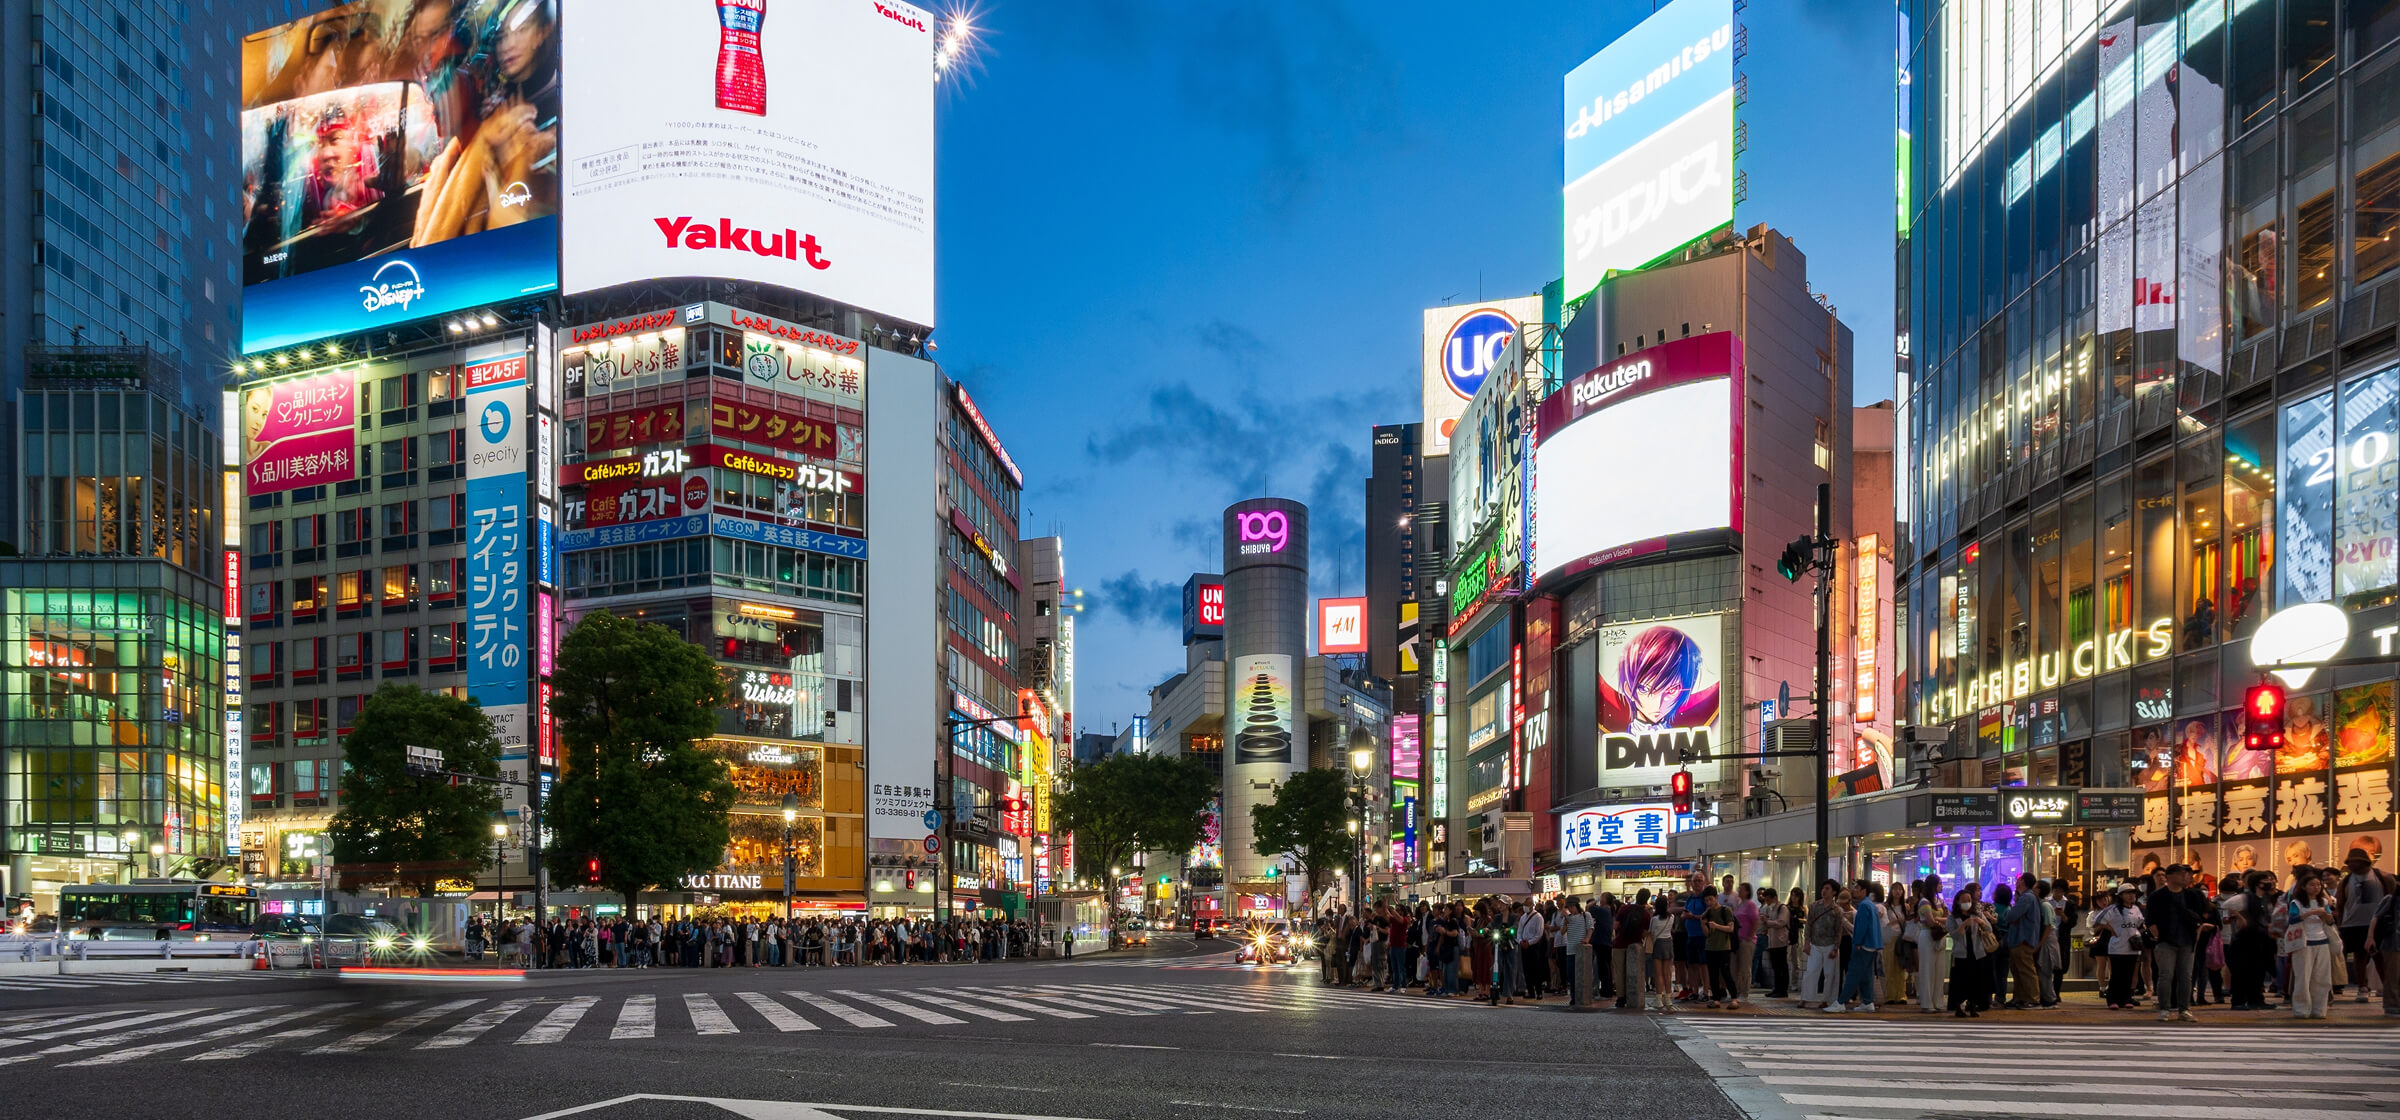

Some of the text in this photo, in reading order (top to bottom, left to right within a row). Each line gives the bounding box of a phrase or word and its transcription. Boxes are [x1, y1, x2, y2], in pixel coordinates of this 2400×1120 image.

[873, 1, 926, 32] Yakult
[1566, 24, 1730, 140] Hisamitsu
[1572, 140, 1722, 262] サロンパス
[654, 216, 831, 271] Yakult
[360, 283, 425, 312] Disney+
[571, 309, 677, 343] しゃぶしゃぶバイキング
[731, 309, 859, 355] しゃぶしゃぶバイキング
[471, 362, 520, 384] 当ビル5F
[620, 343, 679, 376] しゃぶ葉
[566, 366, 583, 384] 9F
[786, 356, 859, 394] しゃぶ葉
[1573, 359, 1651, 406] Rakuten
[292, 382, 349, 410] 品川スキン
[293, 403, 344, 428] クリニック
[588, 408, 681, 445] プライス
[712, 403, 832, 449] コンタクト
[1374, 437, 1399, 445] INDIGO
[262, 447, 350, 484] 品川美容外科
[473, 444, 520, 470] eyecity
[583, 449, 690, 481] Caféレストラン ガスト
[723, 453, 851, 494] Caféレストラン ガスト
[1506, 395, 1522, 561] もんじゃ
[618, 486, 676, 521] ガスト
[687, 490, 706, 501] ガスト
[565, 501, 585, 521] 7F
[564, 531, 590, 547] AEON
[599, 518, 684, 544] 英会話イーオン
[718, 519, 755, 537] AEON
[764, 525, 864, 555] 英会話イーオン
[1237, 511, 1288, 552] 109
[1241, 543, 1270, 555] SHIBUYA
[1588, 547, 1632, 566] Rakuten Vision
[473, 507, 497, 670] アイシティ
[502, 504, 520, 669] コンタクトの
[1203, 589, 1222, 604] UN
[48, 603, 115, 612] SHIBUYA
[1203, 605, 1224, 622] QL
[97, 615, 154, 628] CITY
[1331, 616, 1355, 634] H&M
[1931, 618, 2173, 723] STARBUCKS
[227, 696, 239, 704] 5F
[741, 682, 796, 705] Ushi8
[227, 713, 239, 722] 3F
[1525, 710, 1549, 751] クスリ
[229, 738, 240, 756] 内科
[1605, 730, 1713, 770] DMM
[229, 760, 240, 799] 産婦人科
[874, 784, 932, 798] 広告主募集中
[875, 807, 926, 818] 03-3369-815
[1945, 807, 1968, 816] 渋谷駅
[998, 838, 1018, 859] LUSH
[2121, 921, 2136, 929] adid
